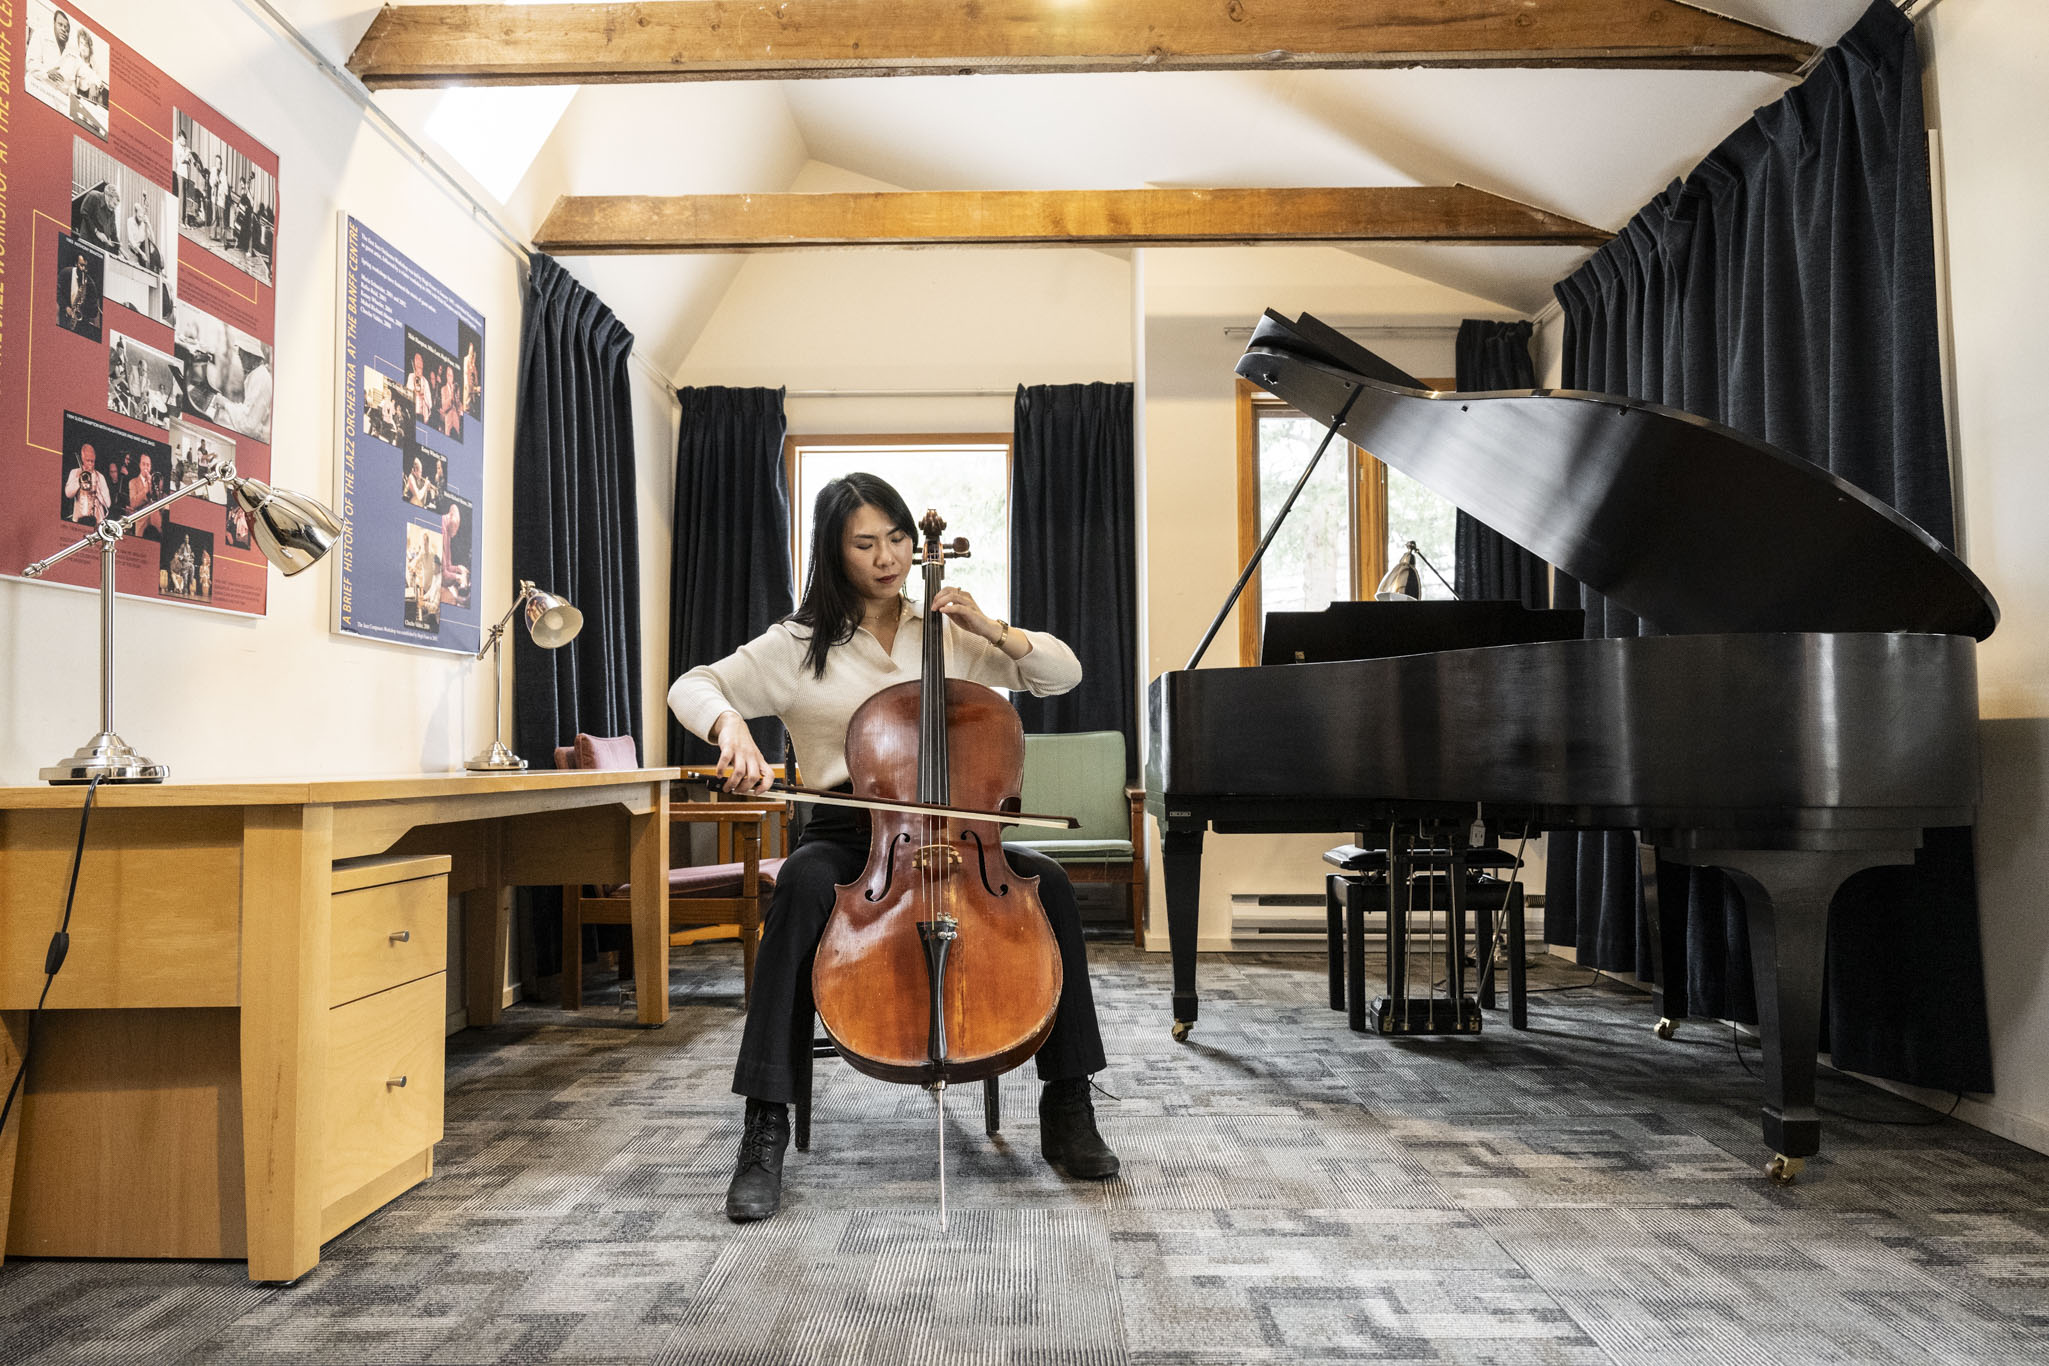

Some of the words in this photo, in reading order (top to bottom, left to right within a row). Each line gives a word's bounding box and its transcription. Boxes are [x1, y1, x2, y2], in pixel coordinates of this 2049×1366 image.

[0, 31, 11, 96] BANFF
[349, 222, 358, 271] CENTRE
[348, 271, 357, 314] BANFF
[348, 313, 357, 340] THE
[347, 342, 356, 359] AT
[346, 362, 356, 436] ORCHESTRA
[346, 437, 354, 470] JAZZ
[345, 470, 354, 494] THE
[345, 498, 354, 516] OF
[344, 517, 353, 572] HISTORY
[343, 576, 352, 612] BRIEF
[343, 616, 351, 625] A
